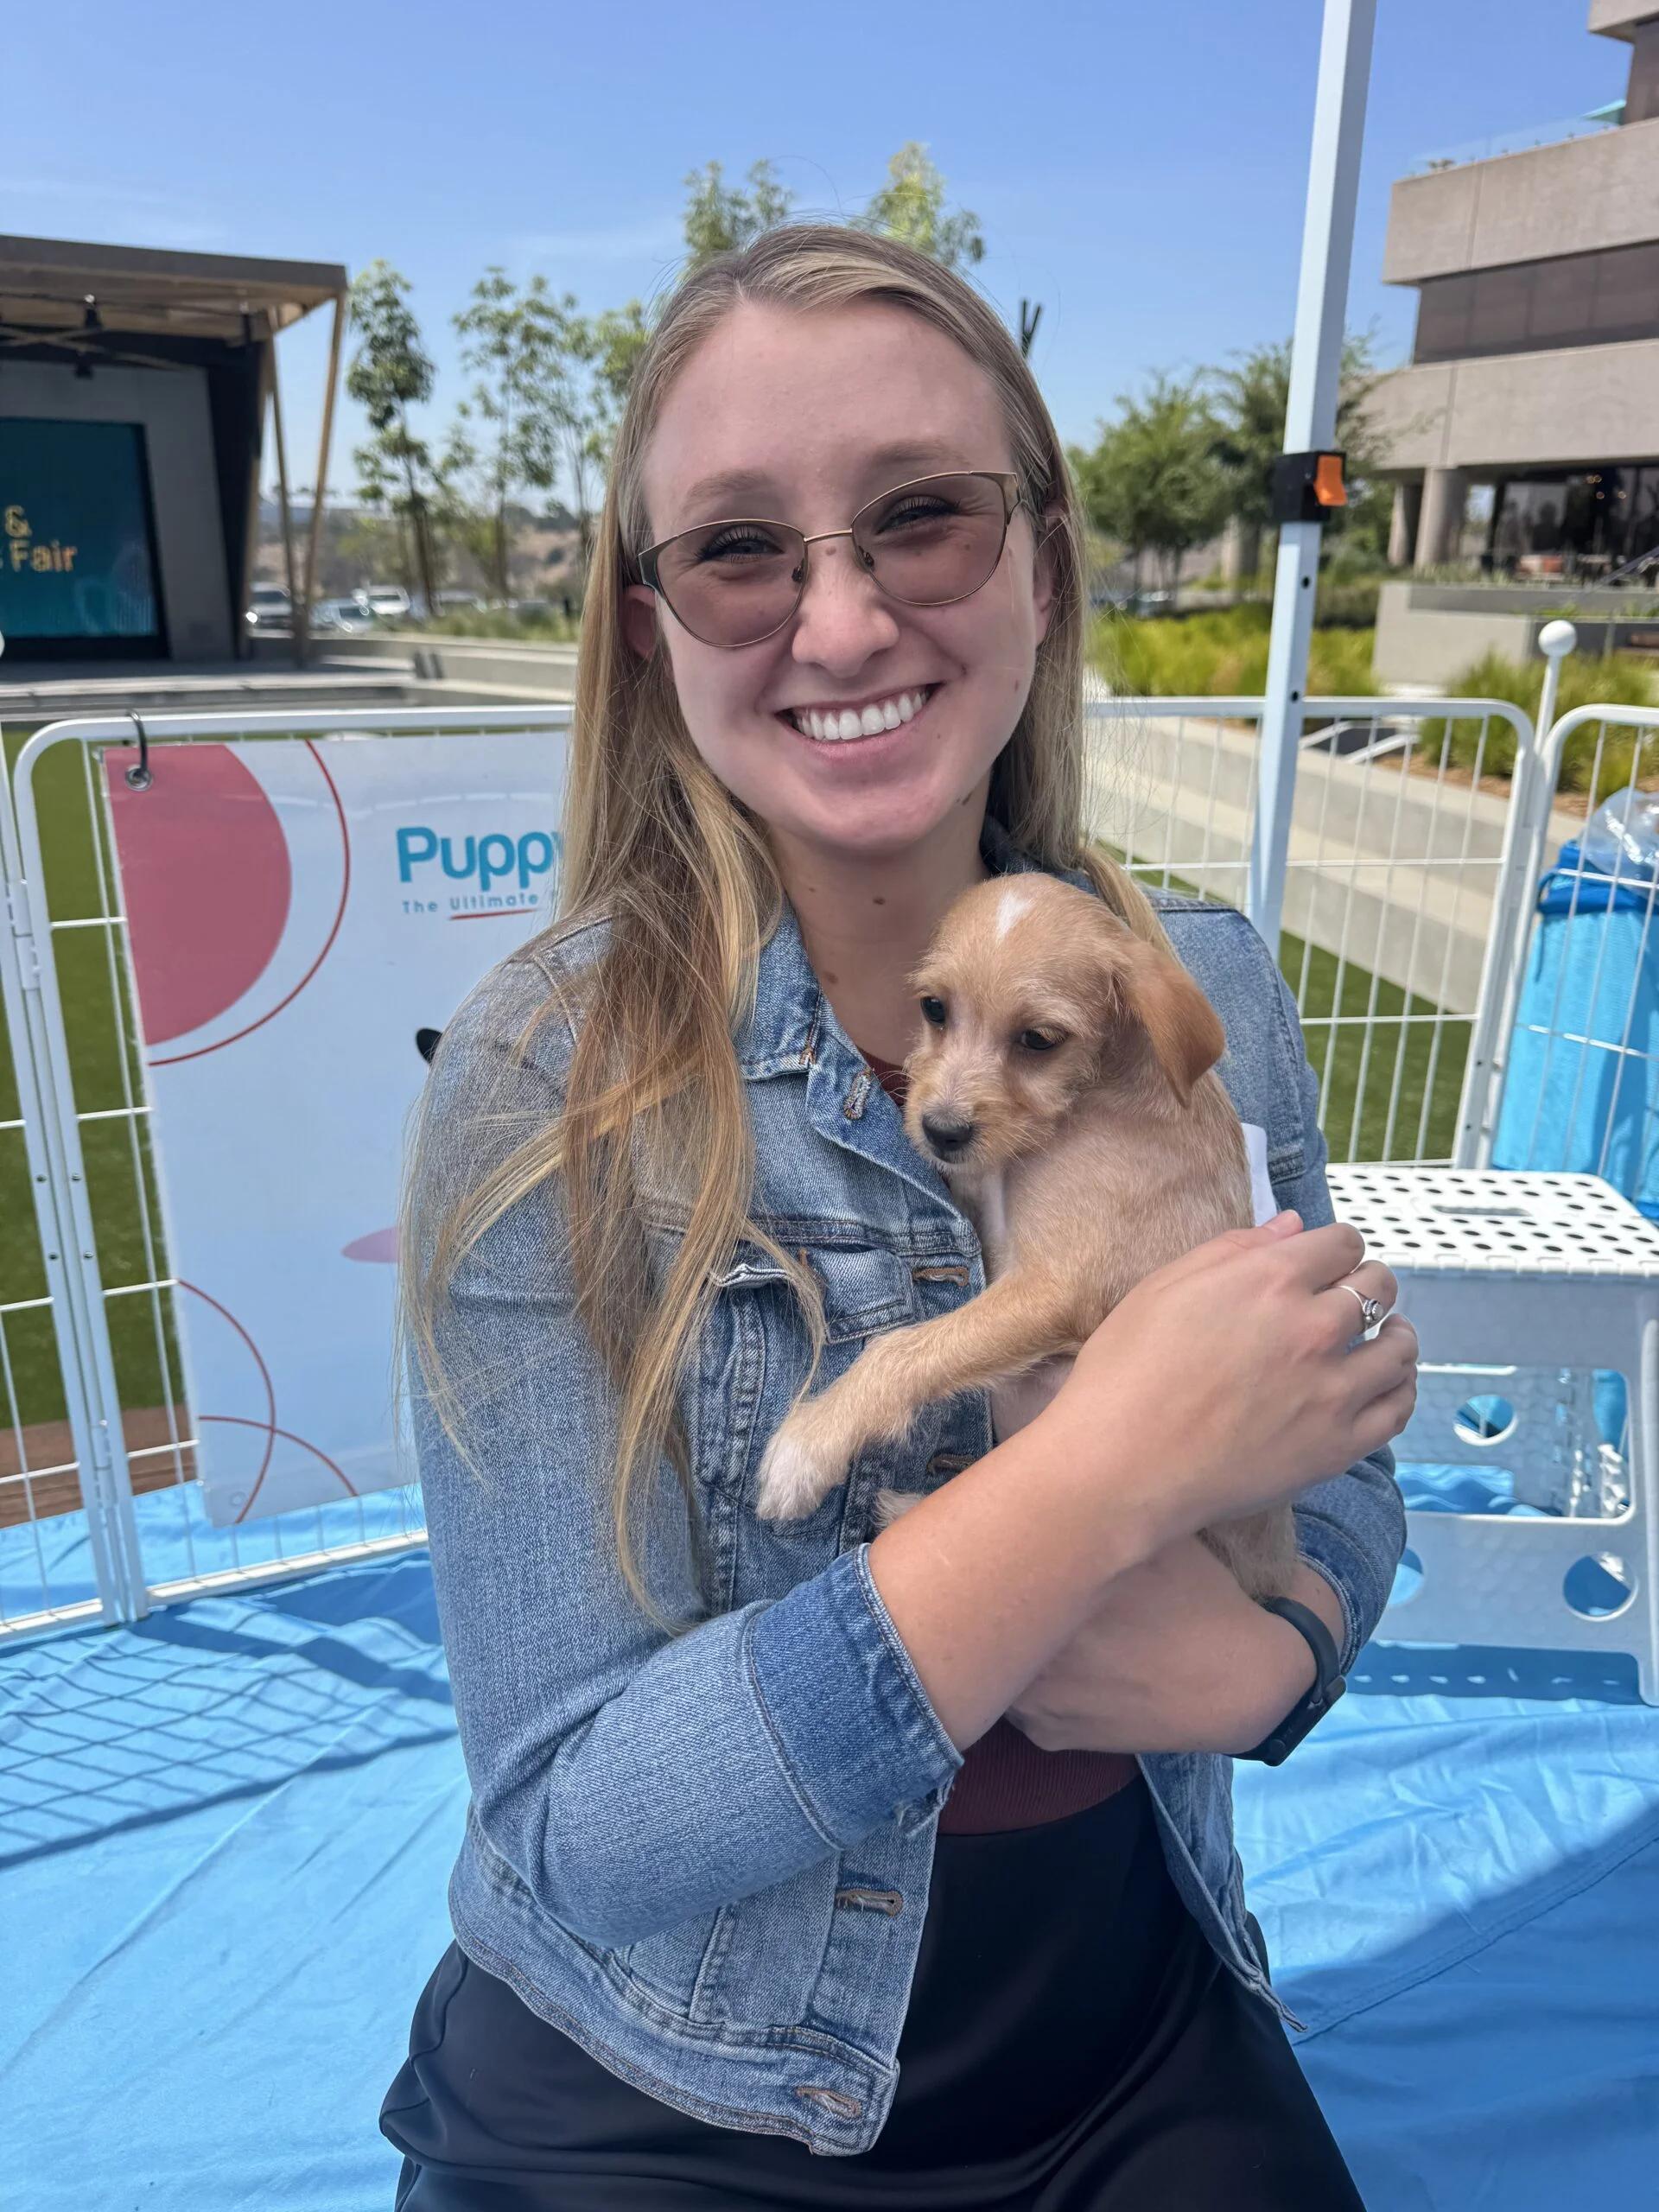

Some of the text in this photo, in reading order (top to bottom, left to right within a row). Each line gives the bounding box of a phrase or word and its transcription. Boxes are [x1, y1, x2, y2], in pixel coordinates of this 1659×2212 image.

[4, 505, 33, 537] &
[10, 539, 79, 573] Fair
[402, 899, 439, 914] The
[449, 893, 539, 911] Ultimate
